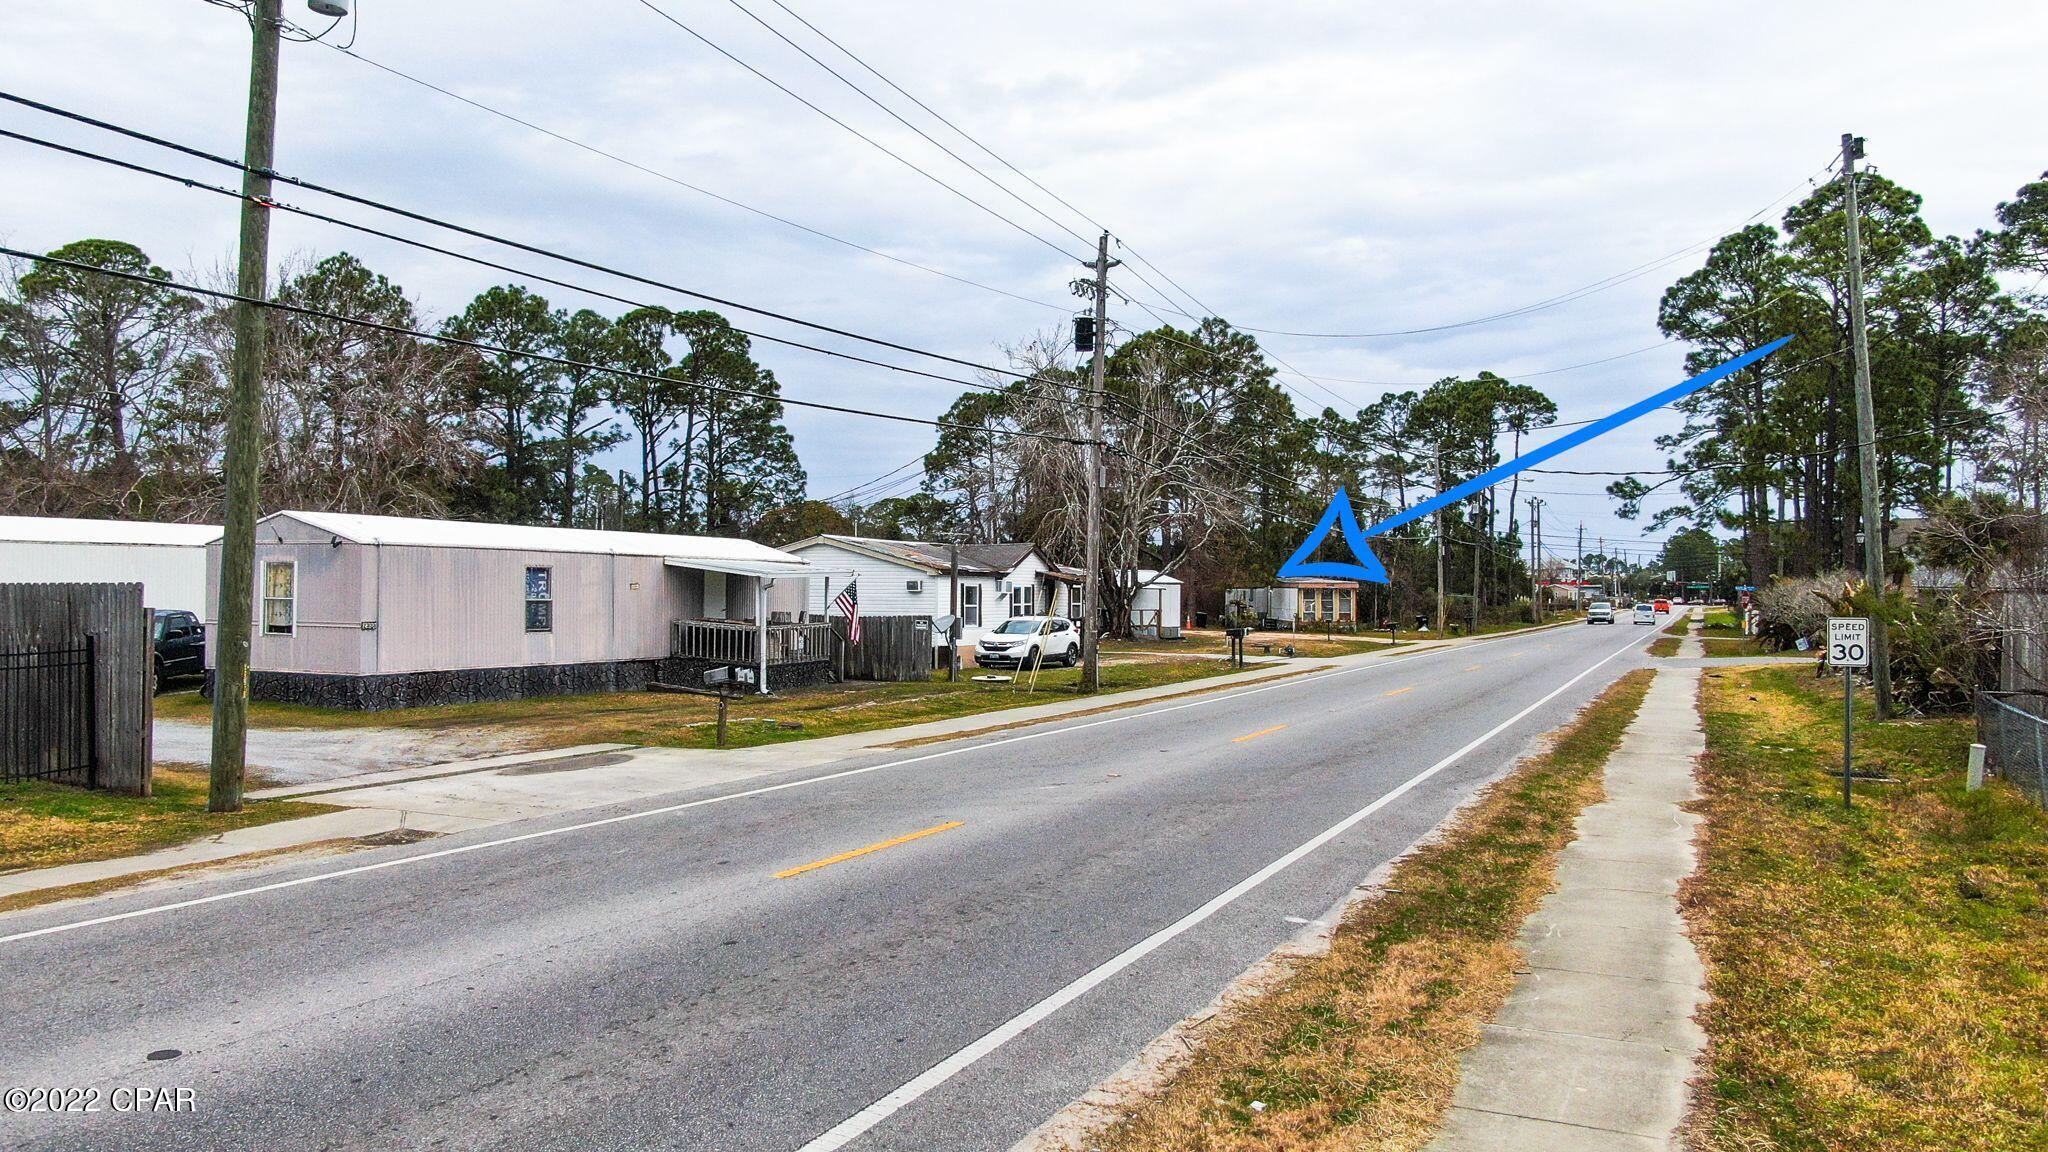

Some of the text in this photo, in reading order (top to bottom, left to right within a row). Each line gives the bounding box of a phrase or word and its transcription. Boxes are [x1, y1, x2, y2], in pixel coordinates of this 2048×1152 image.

[1831, 623, 1865, 631] SPEED
[1835, 633, 1861, 641] LIMIT
[1832, 643, 1864, 661] 30
